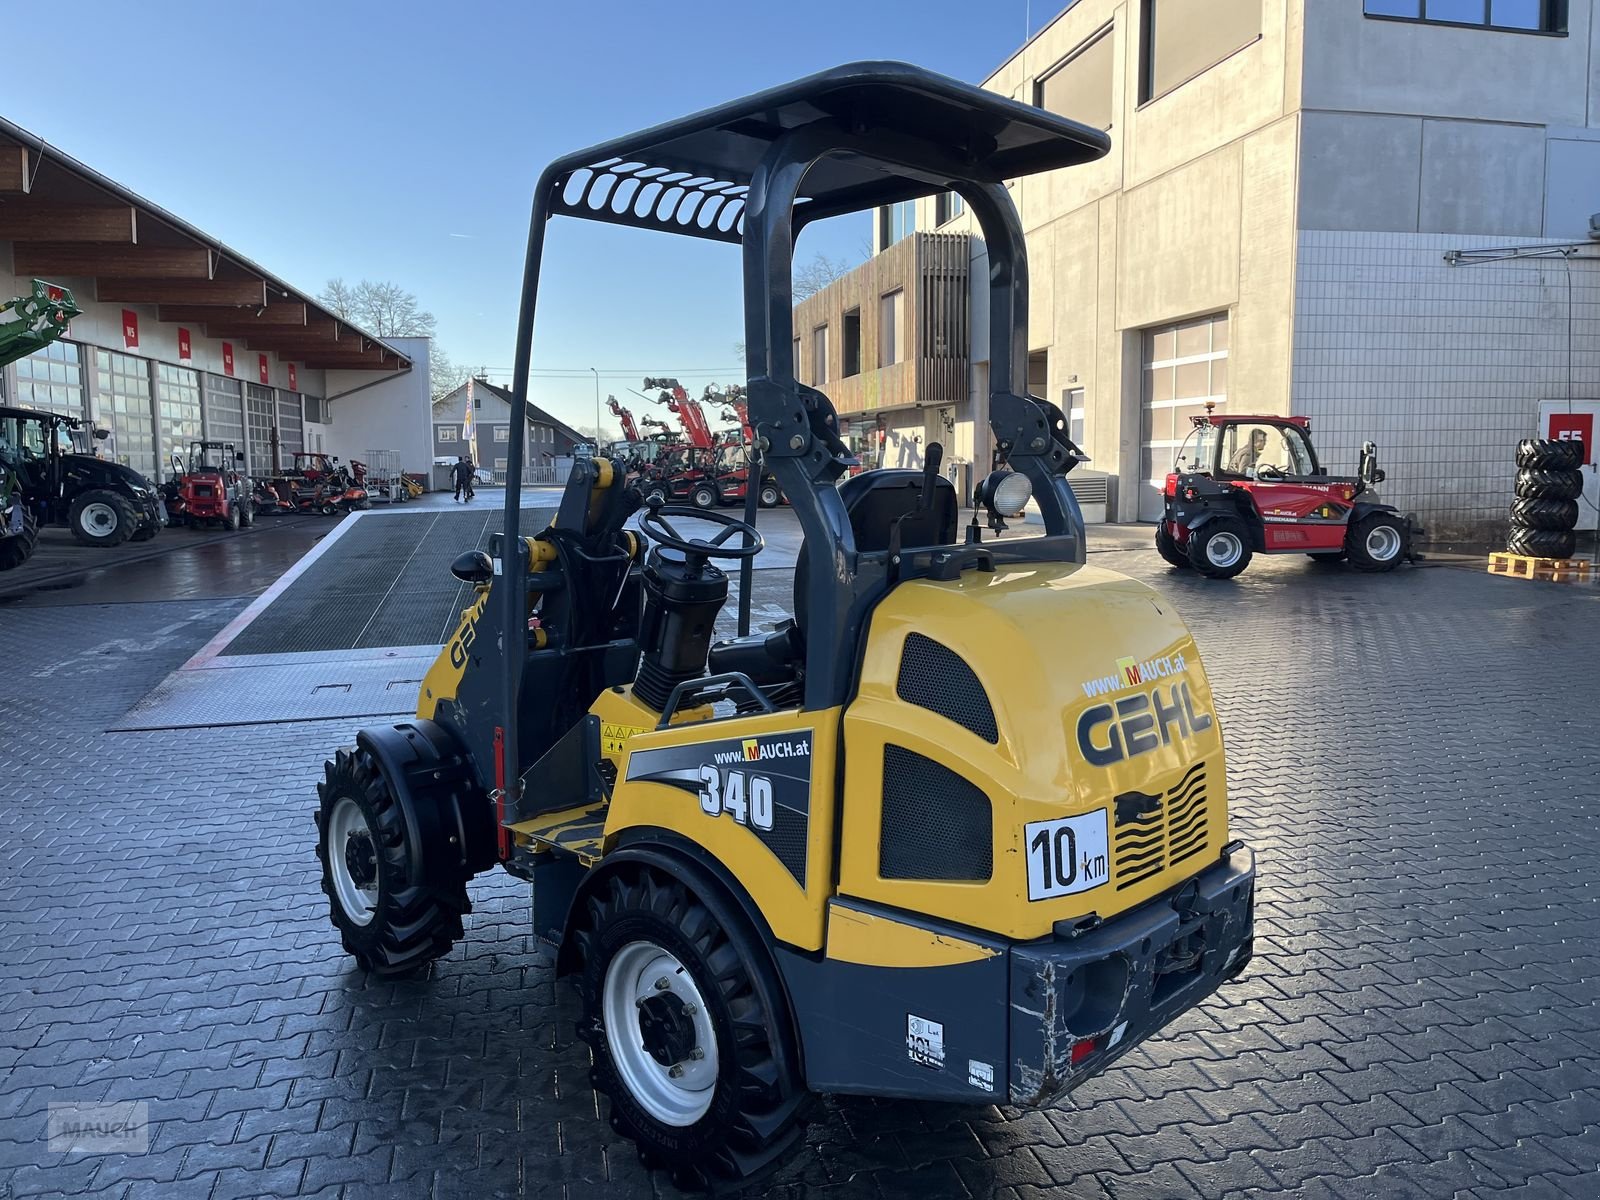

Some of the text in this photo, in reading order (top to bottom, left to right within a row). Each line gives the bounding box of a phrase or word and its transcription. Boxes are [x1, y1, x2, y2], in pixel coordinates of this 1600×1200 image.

[1082, 653, 1187, 698] www.MAUCH.at
[715, 740, 810, 764] www.MAUCH.at
[1076, 680, 1211, 768] GEHL
[696, 761, 775, 832] 340
[1032, 825, 1106, 890] 10 km
